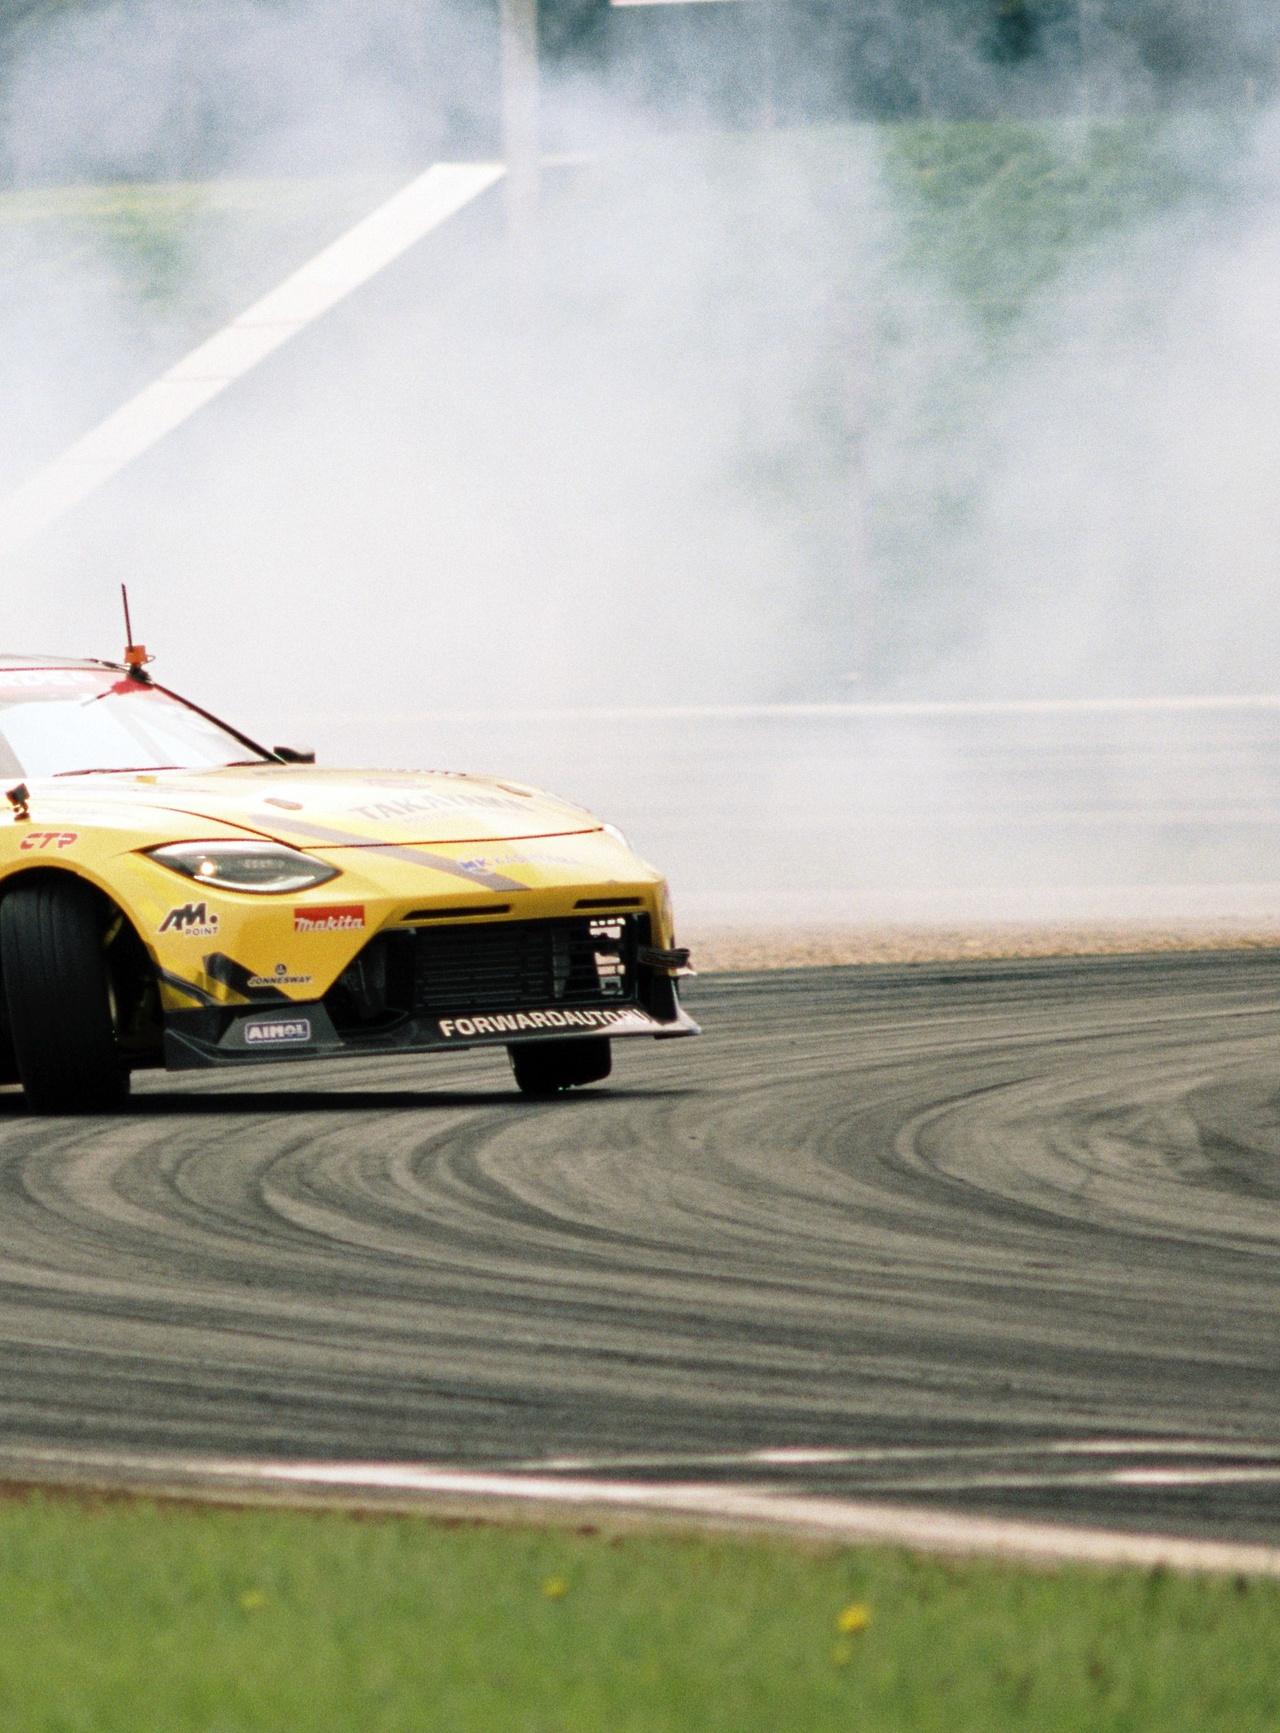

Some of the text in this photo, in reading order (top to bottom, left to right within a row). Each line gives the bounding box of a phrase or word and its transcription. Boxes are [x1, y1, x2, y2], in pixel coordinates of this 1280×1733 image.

[186, 927, 218, 936] POINT
[249, 976, 313, 986] JONNESWAY
[248, 1024, 305, 1040] AIMOL
